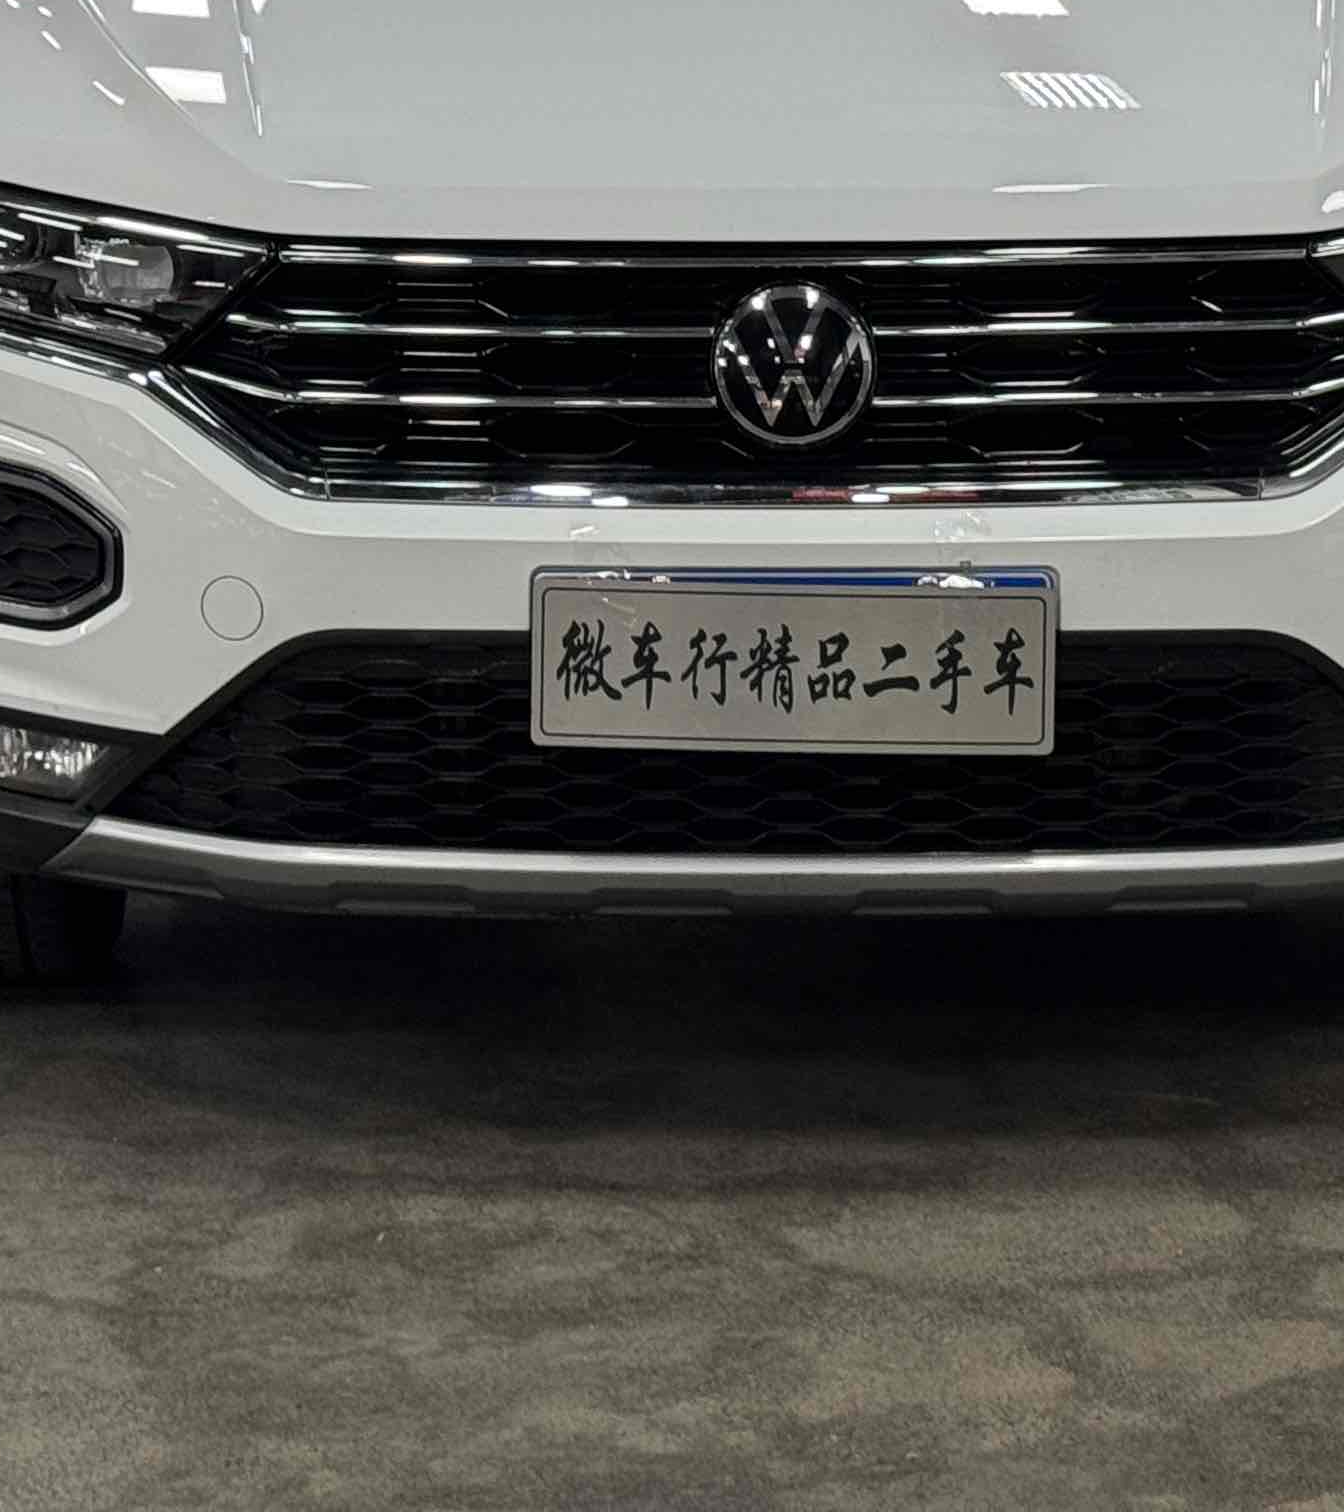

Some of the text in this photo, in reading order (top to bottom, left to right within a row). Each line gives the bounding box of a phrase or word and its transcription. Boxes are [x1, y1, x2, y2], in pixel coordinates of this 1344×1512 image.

[557, 619, 1035, 716] 微车行精品二手车
